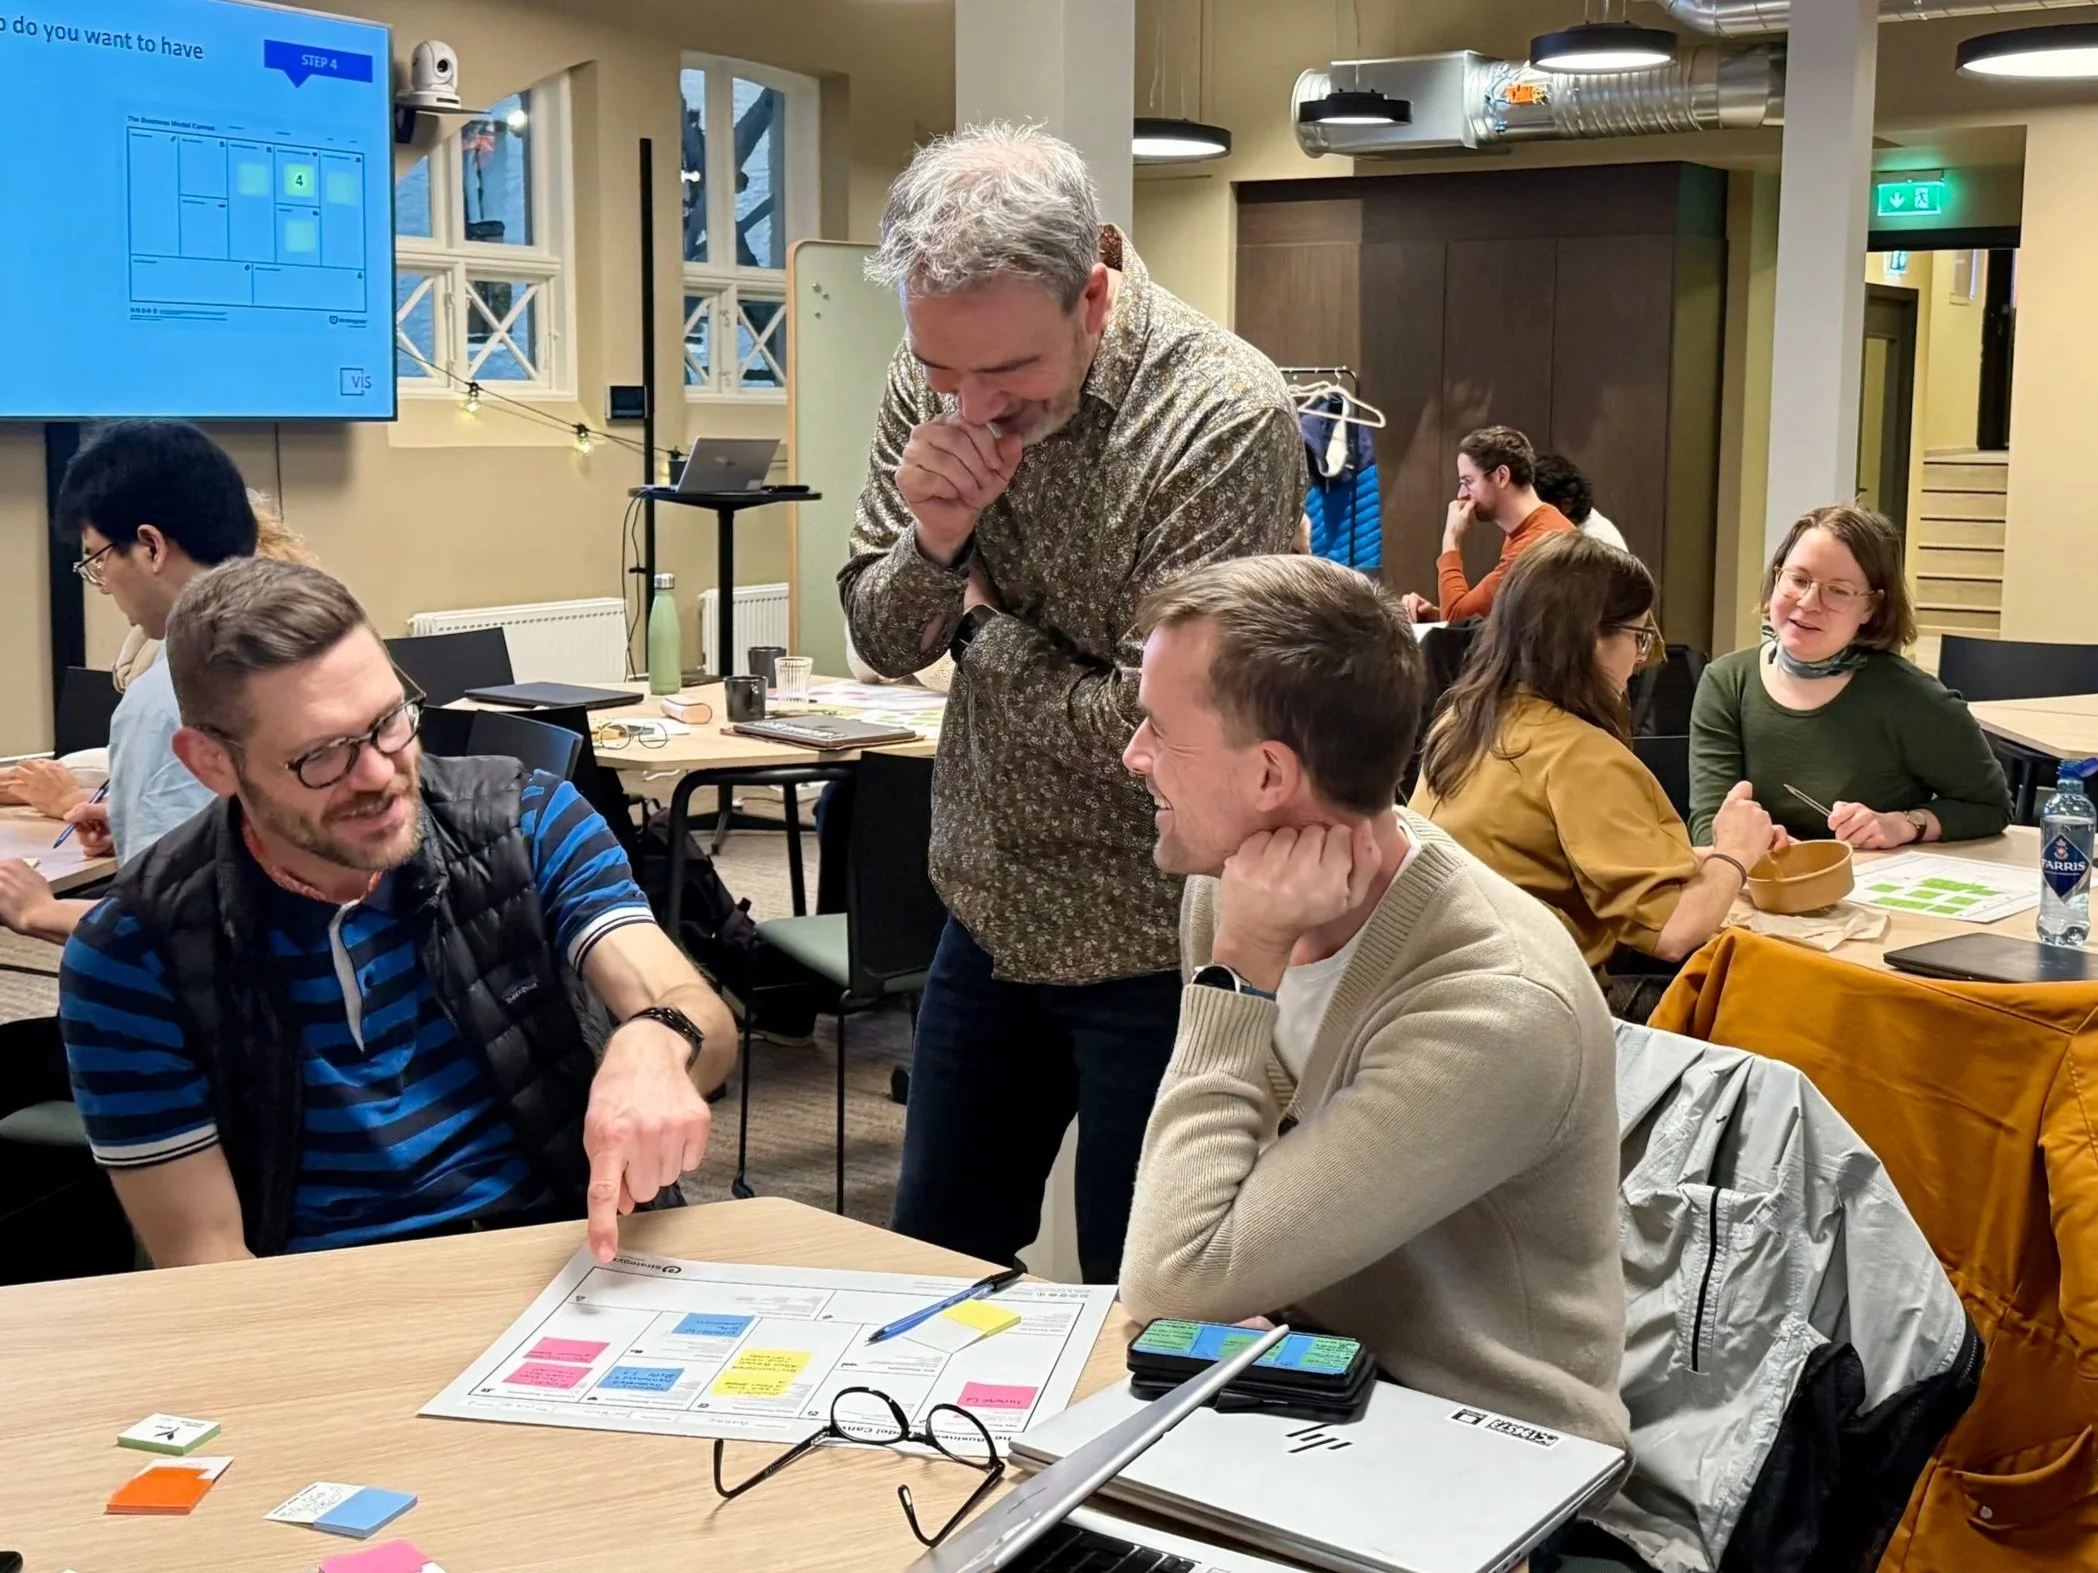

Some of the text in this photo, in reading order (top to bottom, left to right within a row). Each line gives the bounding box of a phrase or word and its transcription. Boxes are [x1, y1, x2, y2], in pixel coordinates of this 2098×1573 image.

[13, 16, 37, 36] do
[43, 24, 78, 43] you
[84, 29, 132, 50] want
[137, 34, 156, 53] to
[161, 37, 203, 60] have
[301, 54, 338, 71] STEP 4
[295, 174, 304, 187] 4
[351, 375, 373, 389] VIS
[2041, 859, 2086, 871] FARRIS
